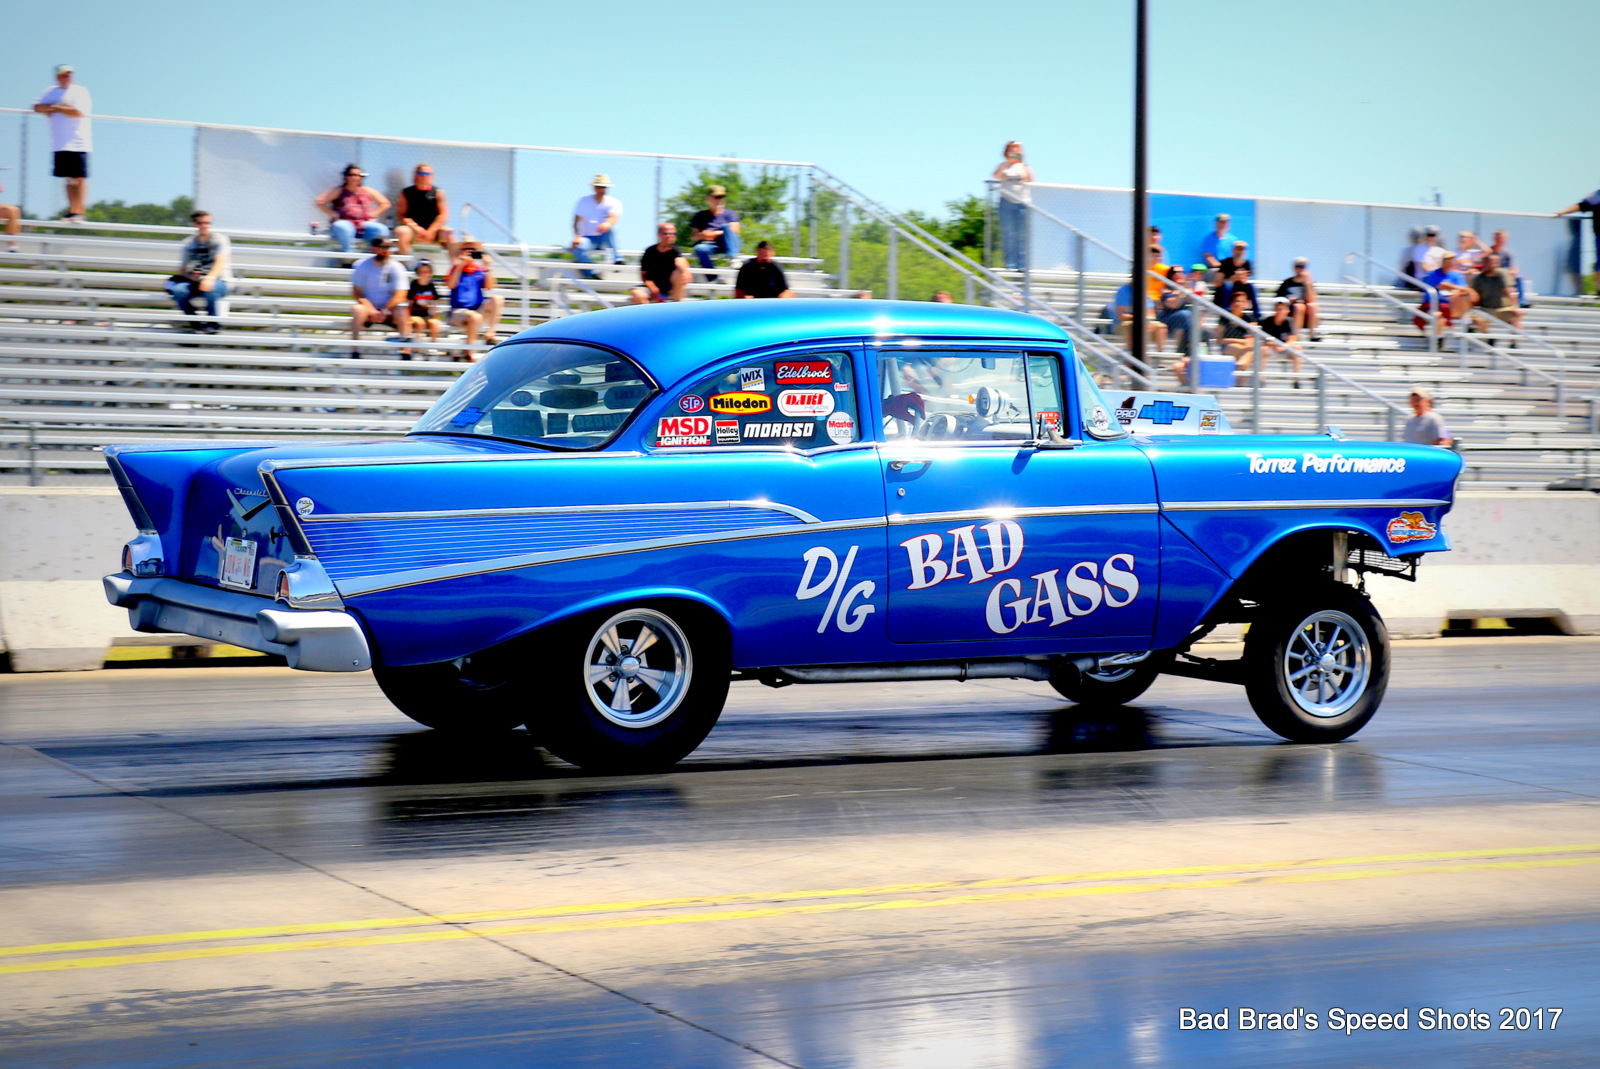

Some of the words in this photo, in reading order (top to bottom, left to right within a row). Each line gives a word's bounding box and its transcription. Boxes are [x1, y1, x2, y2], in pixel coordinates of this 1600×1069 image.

[741, 369, 762, 382] WIX
[777, 365, 830, 379] Edelbrock
[682, 397, 700, 409] STP
[713, 398, 768, 408] Milodon
[785, 392, 827, 405] DART
[1115, 409, 1137, 418] PRO
[661, 418, 709, 436] MSD
[743, 423, 815, 438] MOROSO
[828, 420, 854, 428] Master
[717, 427, 739, 436] Holley
[834, 428, 849, 436] Line
[661, 436, 707, 445] IGNITION
[1245, 453, 1297, 473] Torrez
[1302, 453, 1406, 473] Performance
[899, 519, 1024, 590] BAD
[795, 545, 875, 634] D/G
[985, 553, 1140, 634] GASS
